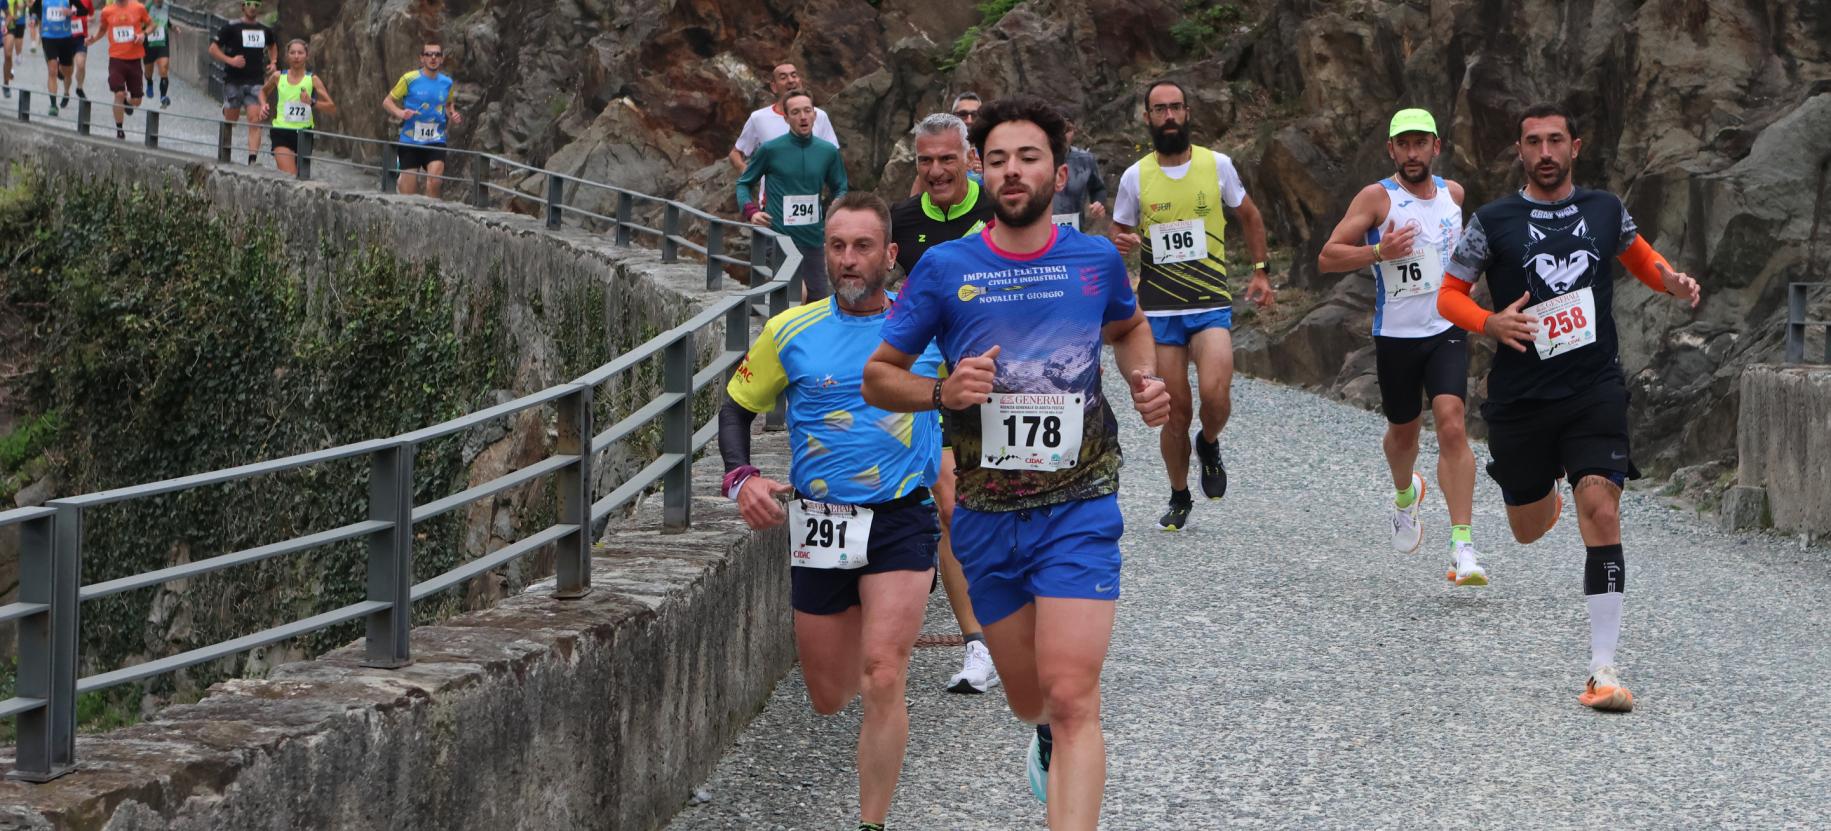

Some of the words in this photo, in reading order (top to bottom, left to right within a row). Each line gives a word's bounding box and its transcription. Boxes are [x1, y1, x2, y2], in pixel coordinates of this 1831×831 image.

[289, 106, 306, 116] 272
[792, 203, 814, 217] 294
[1162, 231, 1194, 251] 196
[963, 269, 1011, 282] IMPIANTI
[1014, 265, 1067, 276] ELETTRICI
[988, 278, 1011, 286] CIVILI
[1020, 273, 1069, 283] INDUSTRIALI
[1397, 262, 1422, 283] 76
[979, 293, 1024, 304] NOVALLET
[1026, 290, 1064, 300] GIORGIO
[1543, 306, 1587, 339] 258
[1015, 395, 1065, 405] GENERALI
[1003, 415, 1061, 448] 178
[805, 518, 848, 549] 291
[793, 550, 811, 559] CIDAC
